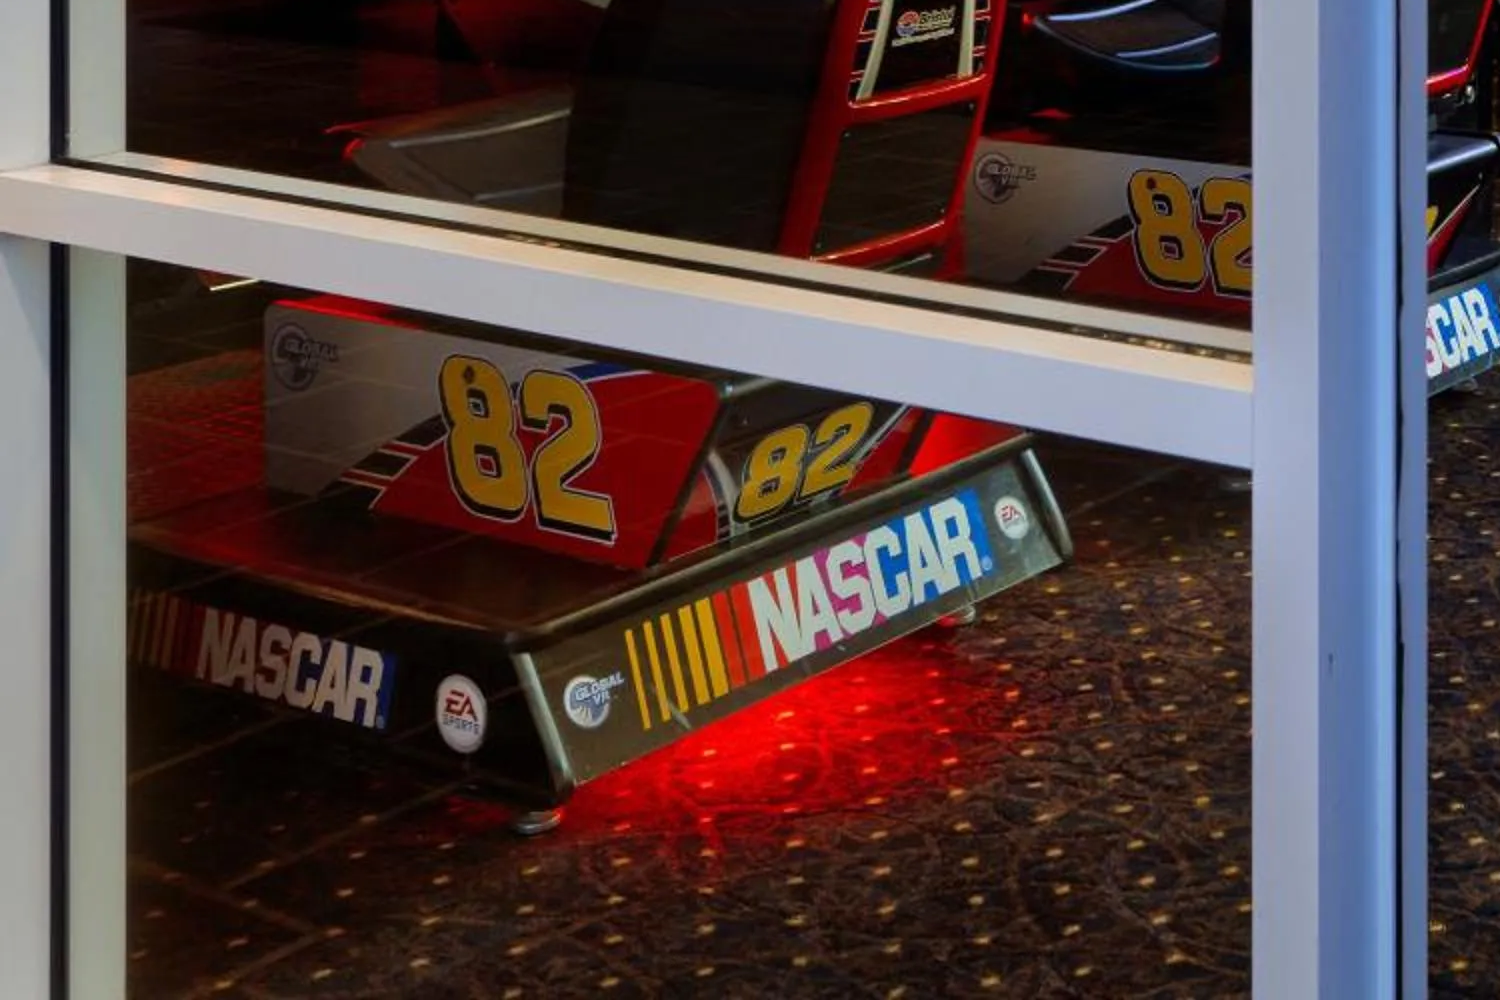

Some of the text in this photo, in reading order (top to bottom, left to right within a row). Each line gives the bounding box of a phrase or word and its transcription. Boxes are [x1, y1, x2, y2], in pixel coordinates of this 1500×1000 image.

[438, 354, 618, 546] 82
[732, 401, 874, 523] 82
[748, 497, 982, 673] NASCAR
[195, 606, 385, 729] NASCAR
[443, 708, 481, 726] SPORTS
[444, 689, 480, 712] EA
